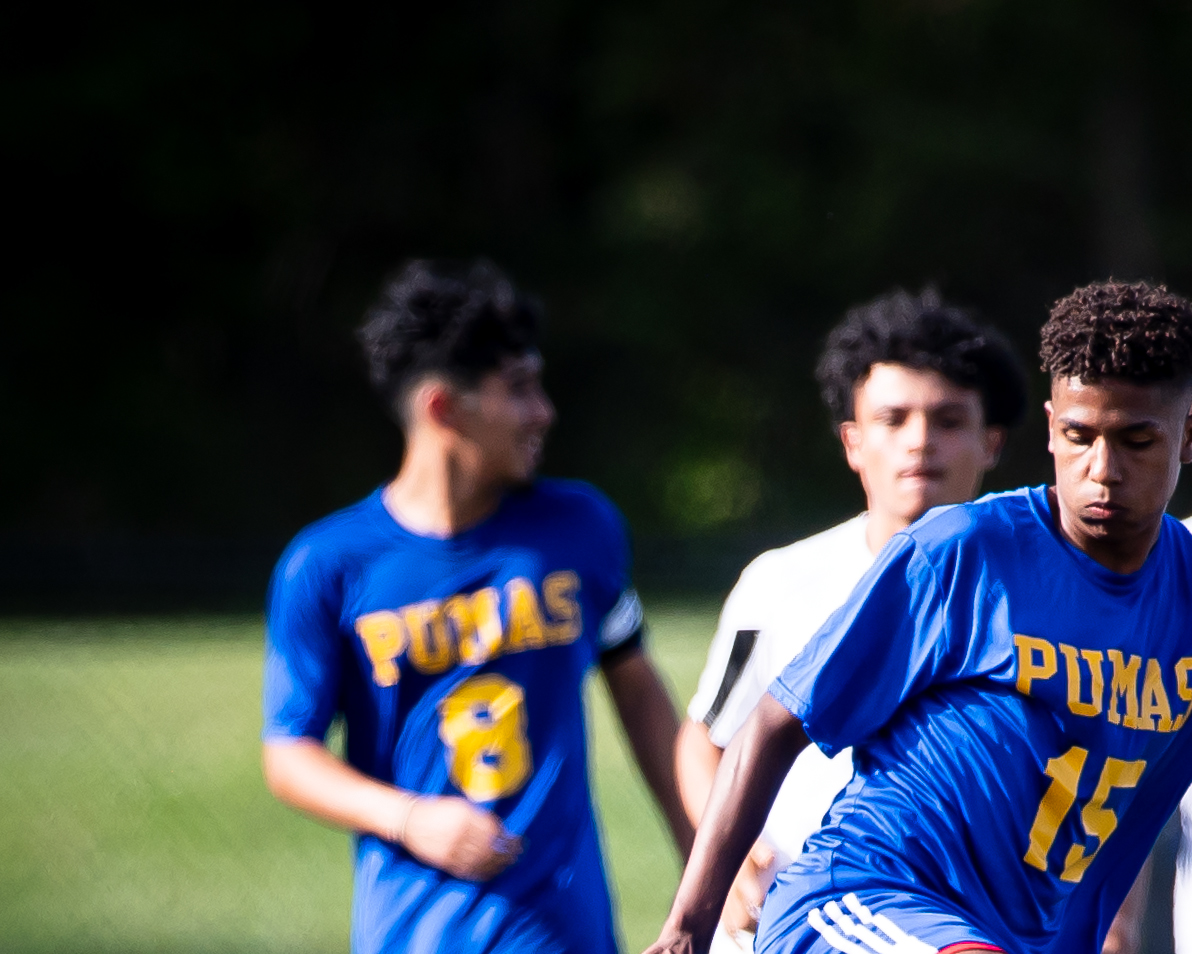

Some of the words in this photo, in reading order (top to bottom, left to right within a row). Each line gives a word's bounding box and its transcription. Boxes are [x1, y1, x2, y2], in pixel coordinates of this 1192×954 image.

[354, 569, 582, 687] PUMAS
[436, 672, 533, 803] 8
[1023, 746, 1147, 883] 15
